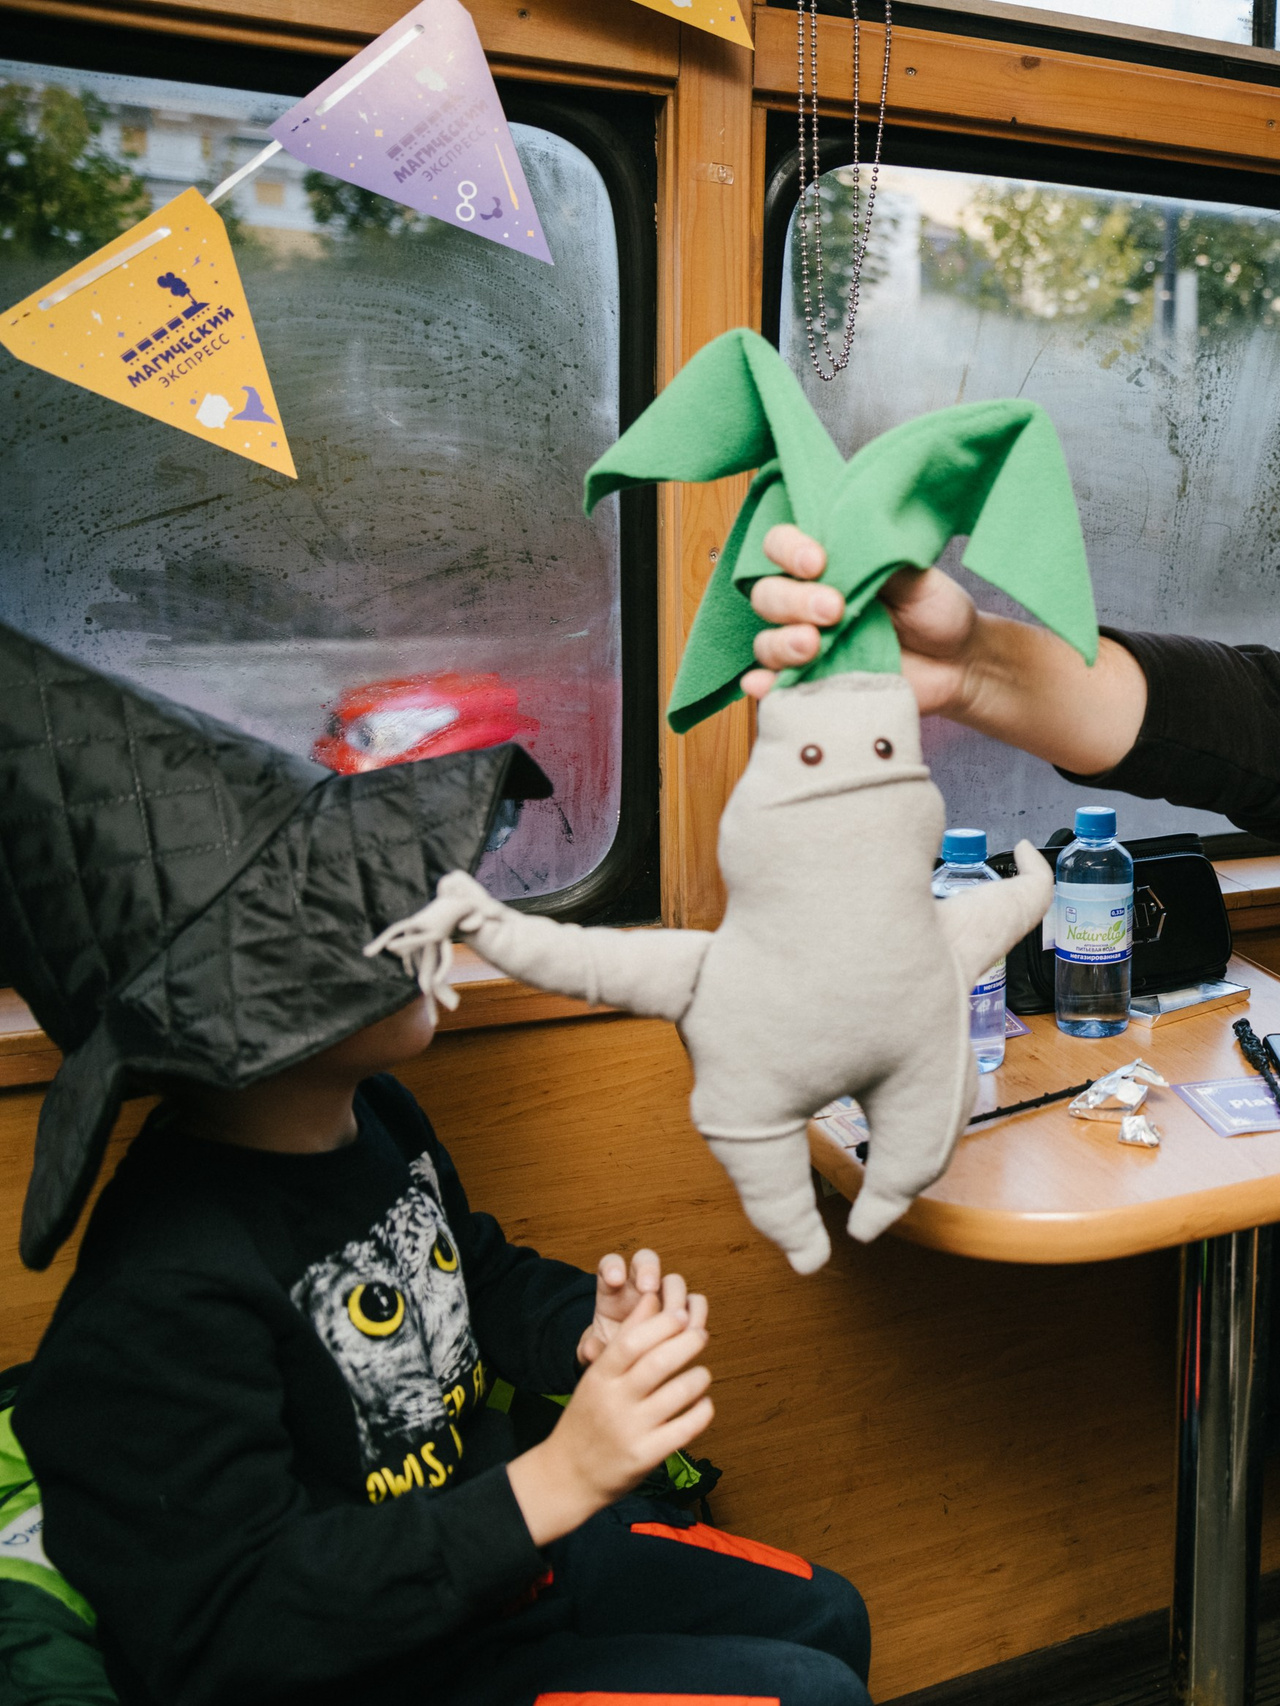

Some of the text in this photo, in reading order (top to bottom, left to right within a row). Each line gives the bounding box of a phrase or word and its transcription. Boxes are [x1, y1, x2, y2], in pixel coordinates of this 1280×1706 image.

[393, 98, 489, 184] МАГИЧЕСКИЙ
[422, 124, 486, 182] ЭКСПРЕСС
[127, 305, 235, 388] МАГИЧЕСКИЙ
[158, 333, 230, 388] ЭКСПРЕСС
[1066, 924, 1122, 942] Naturelia
[1070, 952, 1122, 962] негазированная
